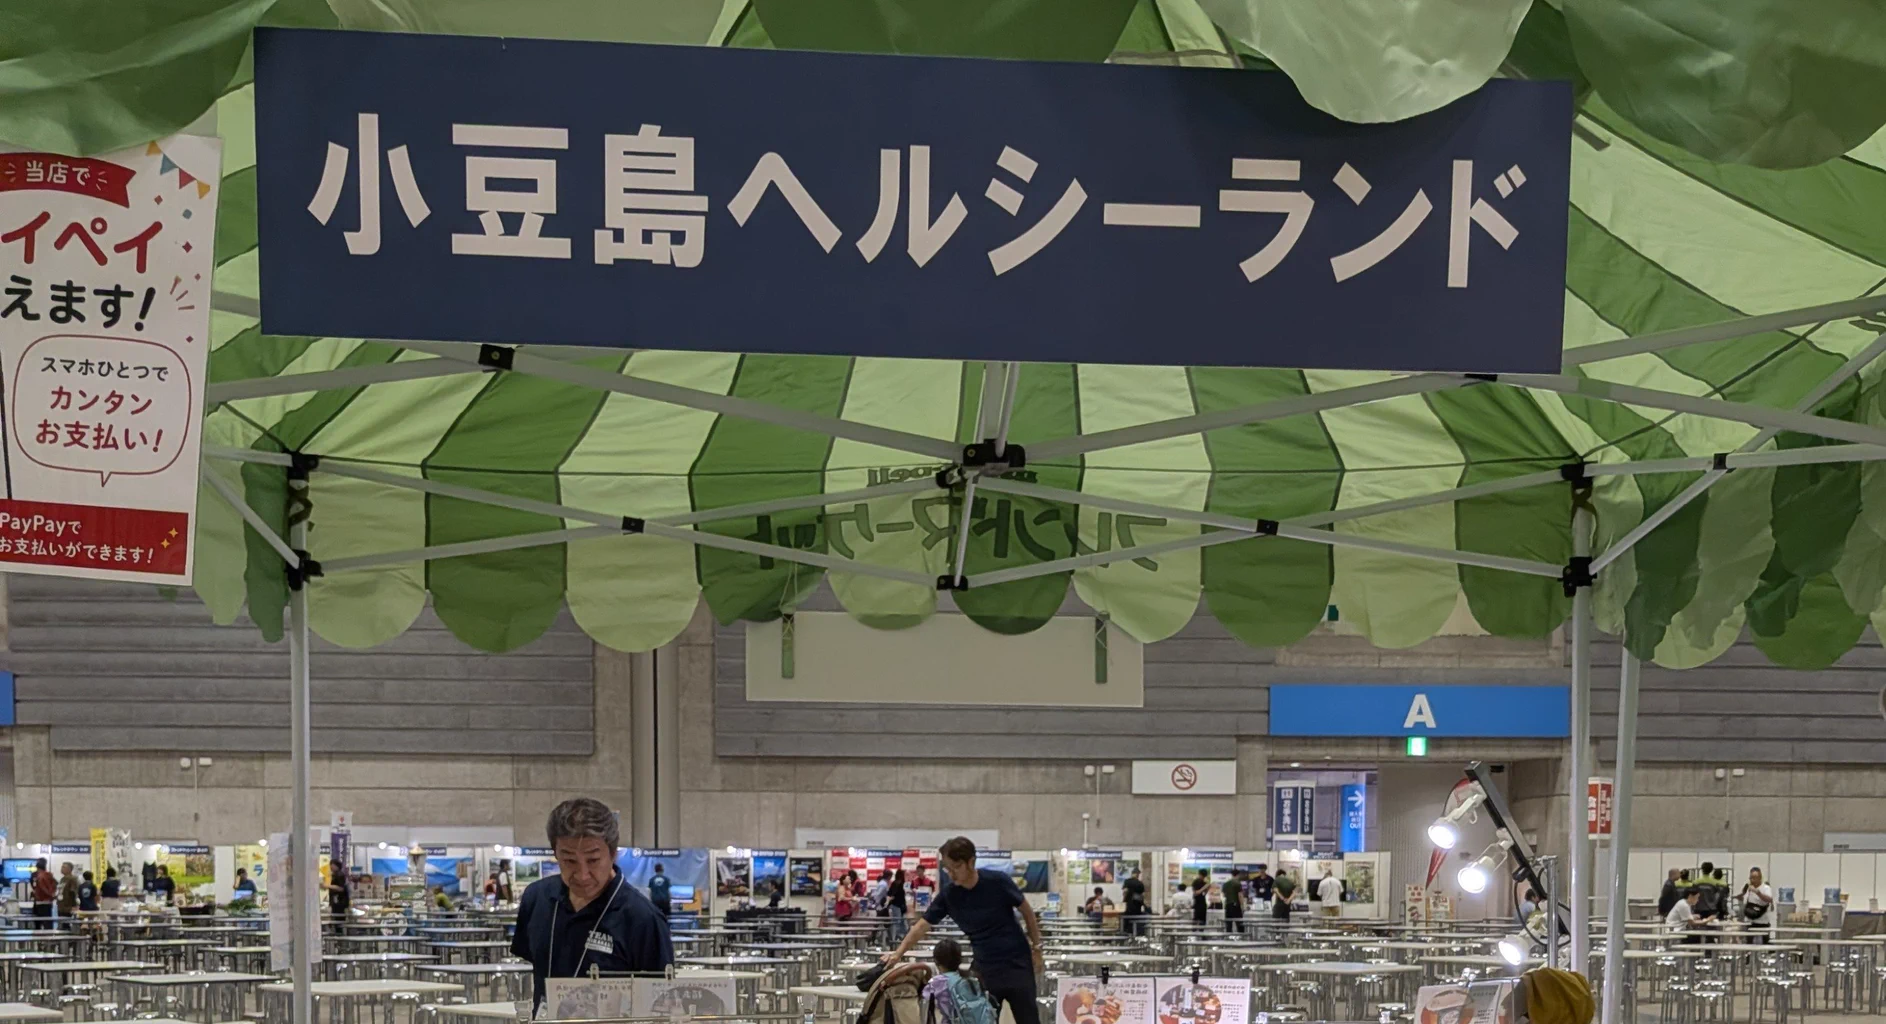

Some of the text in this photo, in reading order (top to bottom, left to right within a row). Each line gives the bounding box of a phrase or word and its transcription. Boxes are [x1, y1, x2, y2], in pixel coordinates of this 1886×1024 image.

[25, 160, 91, 185] 当店で
[308, 112, 1528, 288] 小豆島ヘルシーランド
[1, 211, 163, 274] イペイ
[40, 356, 169, 382] スマホひとつで
[50, 385, 153, 415] カンタン
[36, 419, 163, 453] お支払い!
[0, 513, 81, 535] PayPayで
[0, 538, 154, 564] お支払いができます!
[1404, 694, 1437, 728] A
